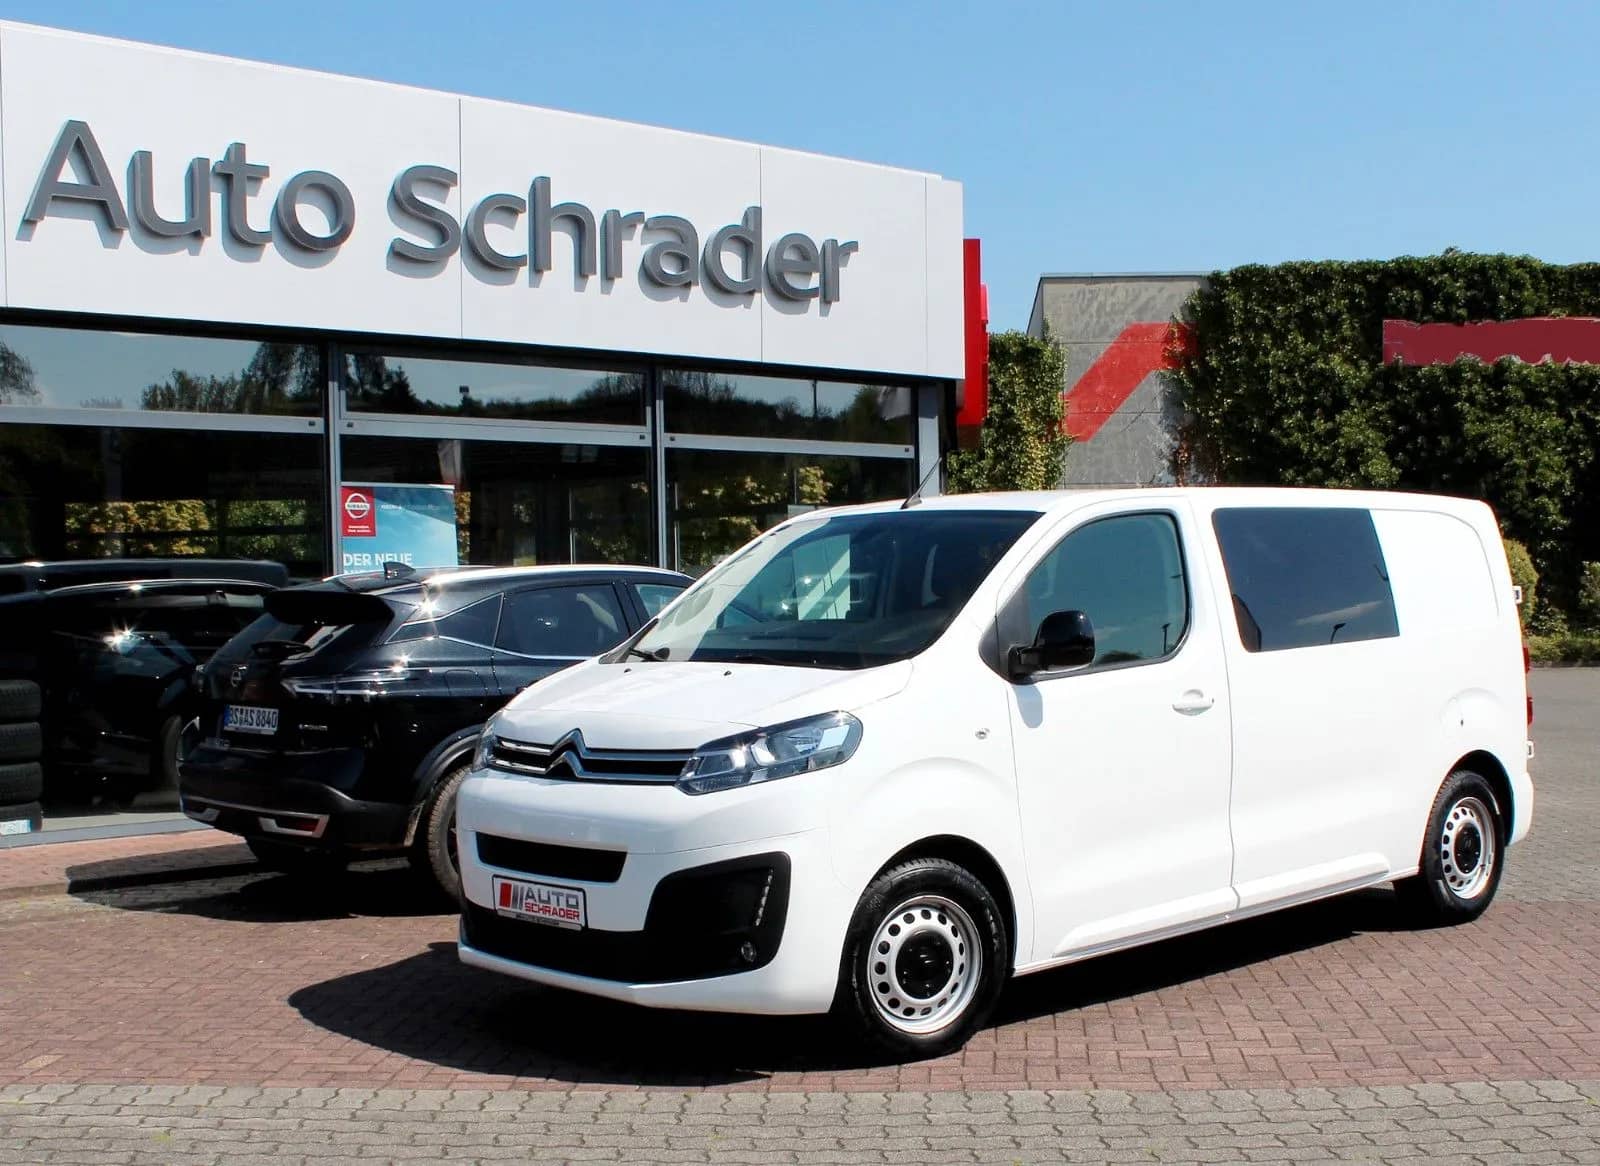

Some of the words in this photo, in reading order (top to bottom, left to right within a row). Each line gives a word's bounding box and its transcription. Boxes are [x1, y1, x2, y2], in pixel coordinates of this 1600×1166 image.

[22, 119, 356, 252] Auto
[390, 164, 858, 303] Schrader
[343, 553, 371, 566] DER
[256, 709, 277, 728] 8840
[525, 886, 579, 910] AUTO
[525, 901, 580, 920] SCHRADER
